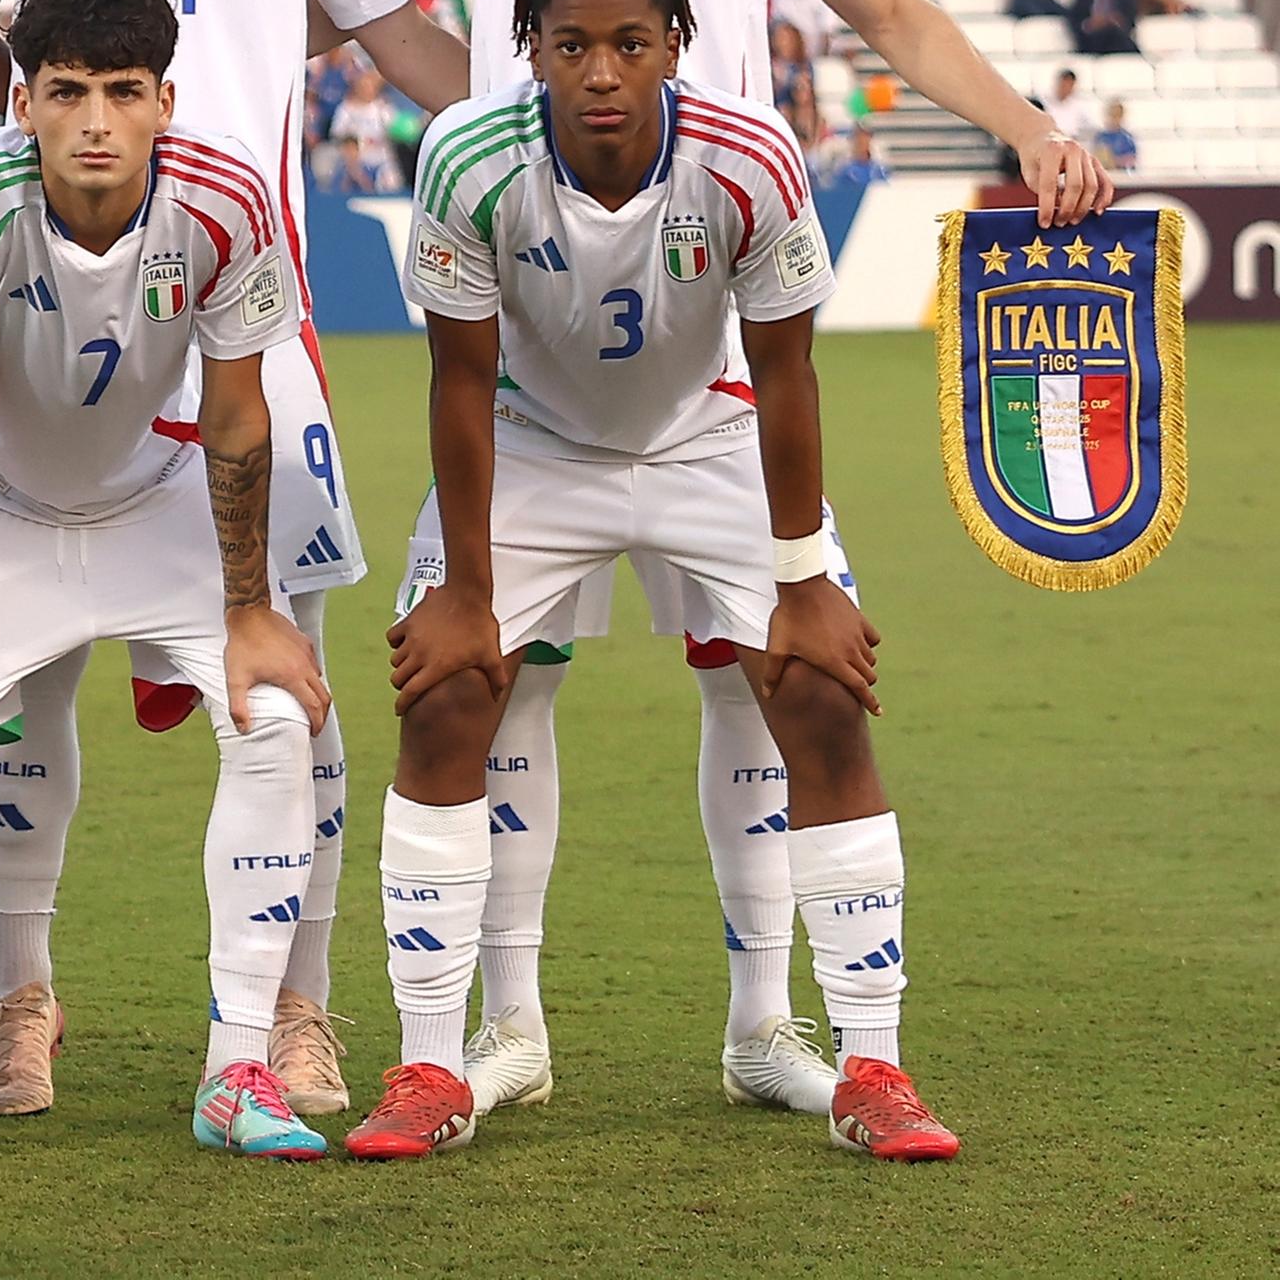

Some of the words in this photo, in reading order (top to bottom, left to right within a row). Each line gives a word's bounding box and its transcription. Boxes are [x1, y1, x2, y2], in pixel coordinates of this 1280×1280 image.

[666, 230, 704, 243] ITALIA
[785, 240, 815, 261] UNITES
[146, 267, 182, 283] ITALIA
[598, 287, 644, 360] 3
[992, 305, 1122, 351] ITALIA
[79, 338, 123, 407] 7
[1039, 354, 1078, 372] FIGC
[1007, 401, 1029, 412] FIFA
[1090, 399, 1111, 410] CUP
[302, 422, 340, 510] 9
[233, 852, 312, 871] ITALIA
